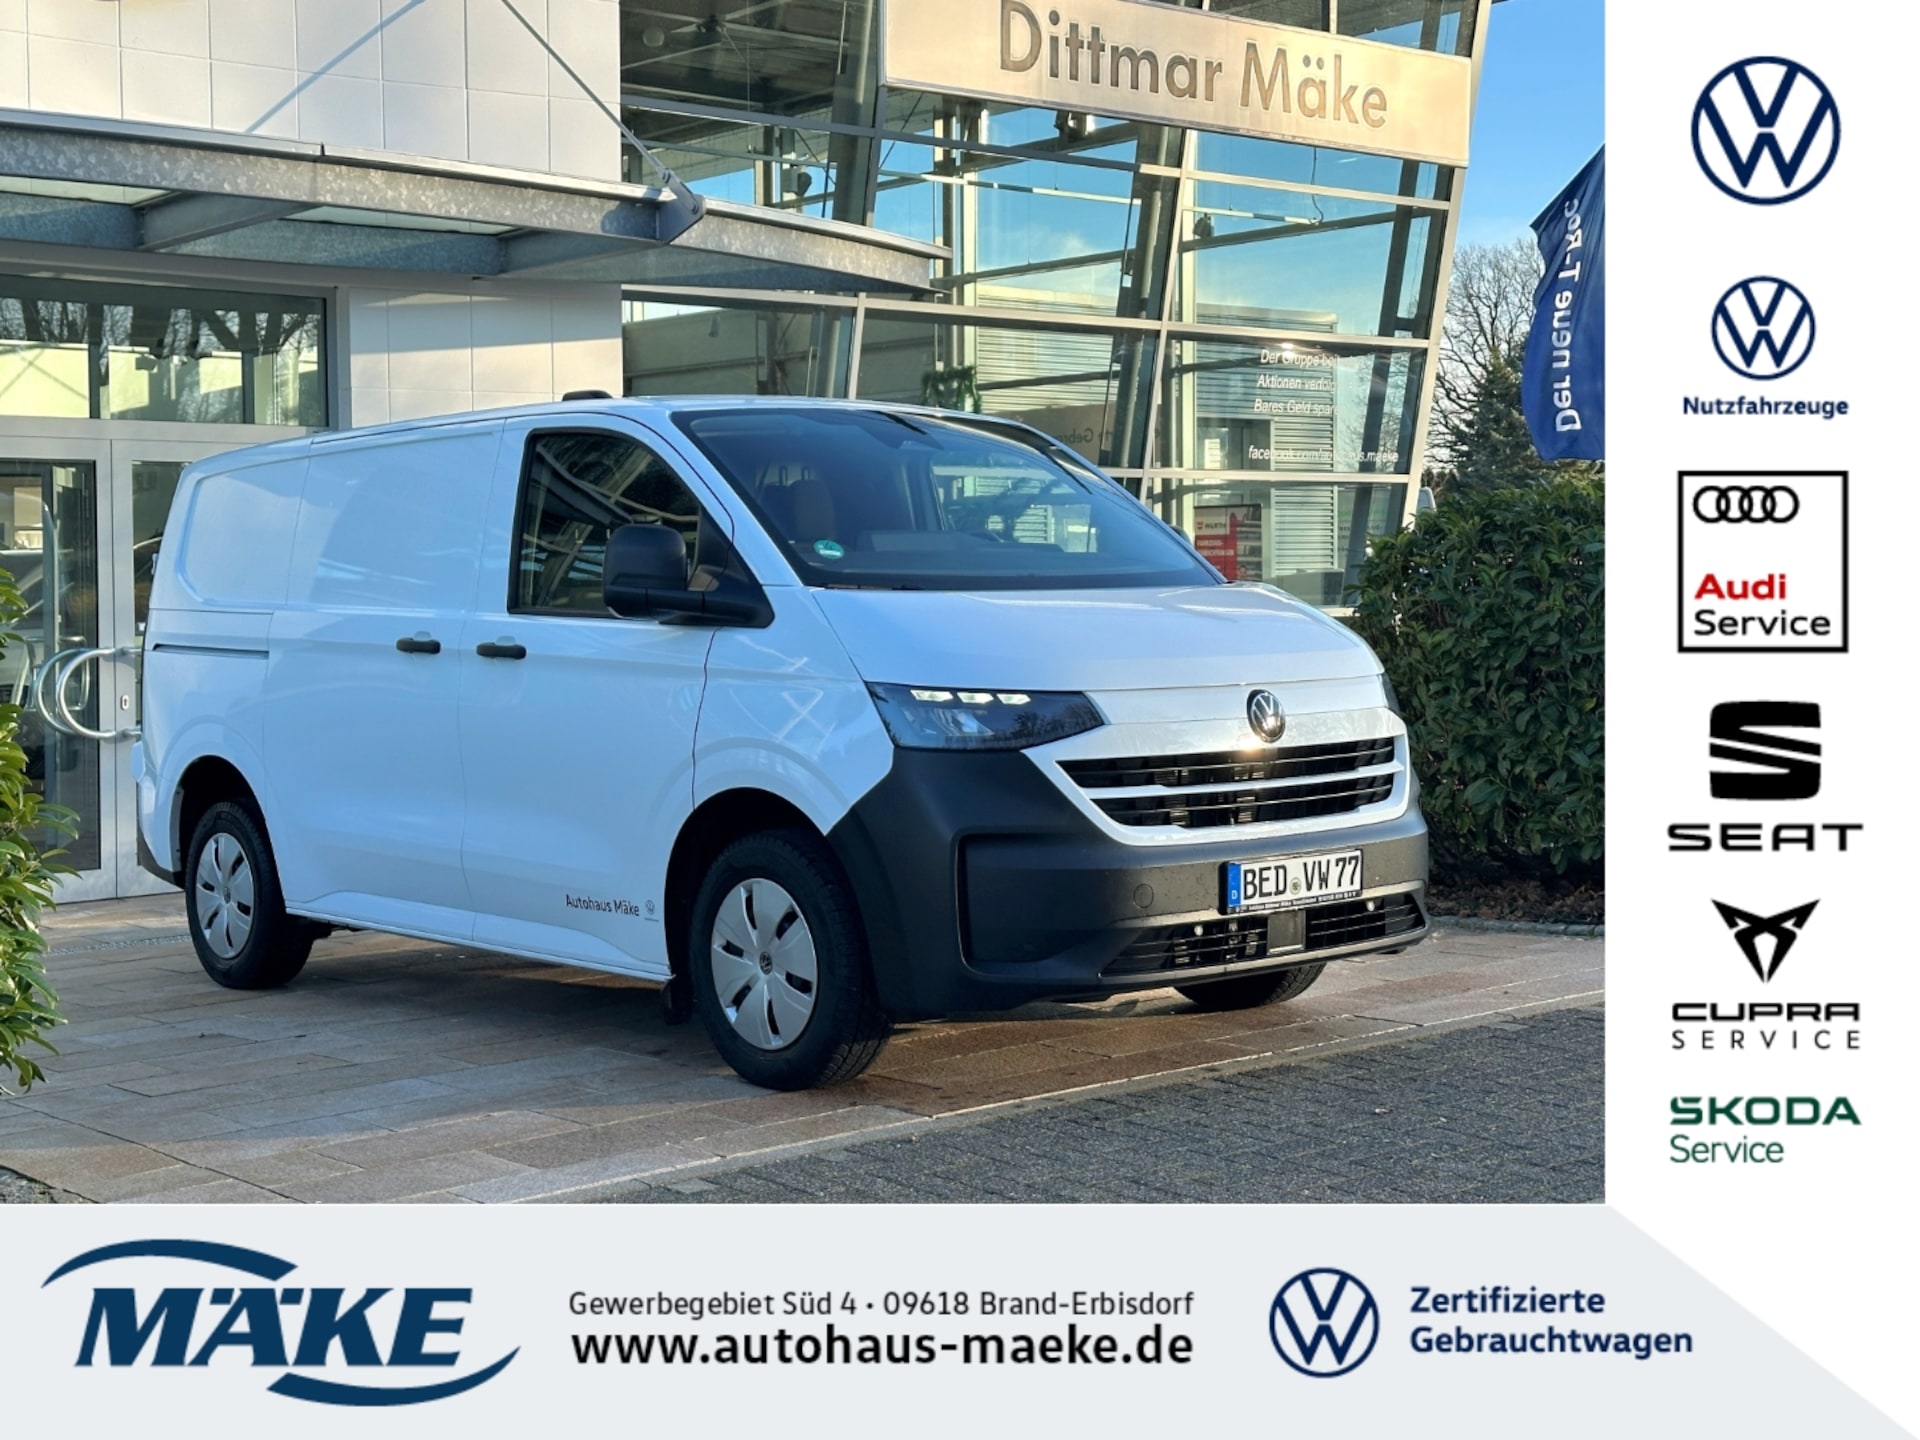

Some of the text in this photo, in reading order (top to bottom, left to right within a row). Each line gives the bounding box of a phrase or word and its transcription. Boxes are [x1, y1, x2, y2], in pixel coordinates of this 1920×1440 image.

[1000, 1, 1388, 129] Dittmar Mäke
[1260, 350, 1281, 364] Der
[1256, 373, 1302, 390] Aktionen
[1254, 398, 1283, 413] Bares
[1287, 399, 1312, 414] Geld
[1244, 855, 1360, 900] BED VW 77
[565, 893, 640, 917] Autohaus Mäke
